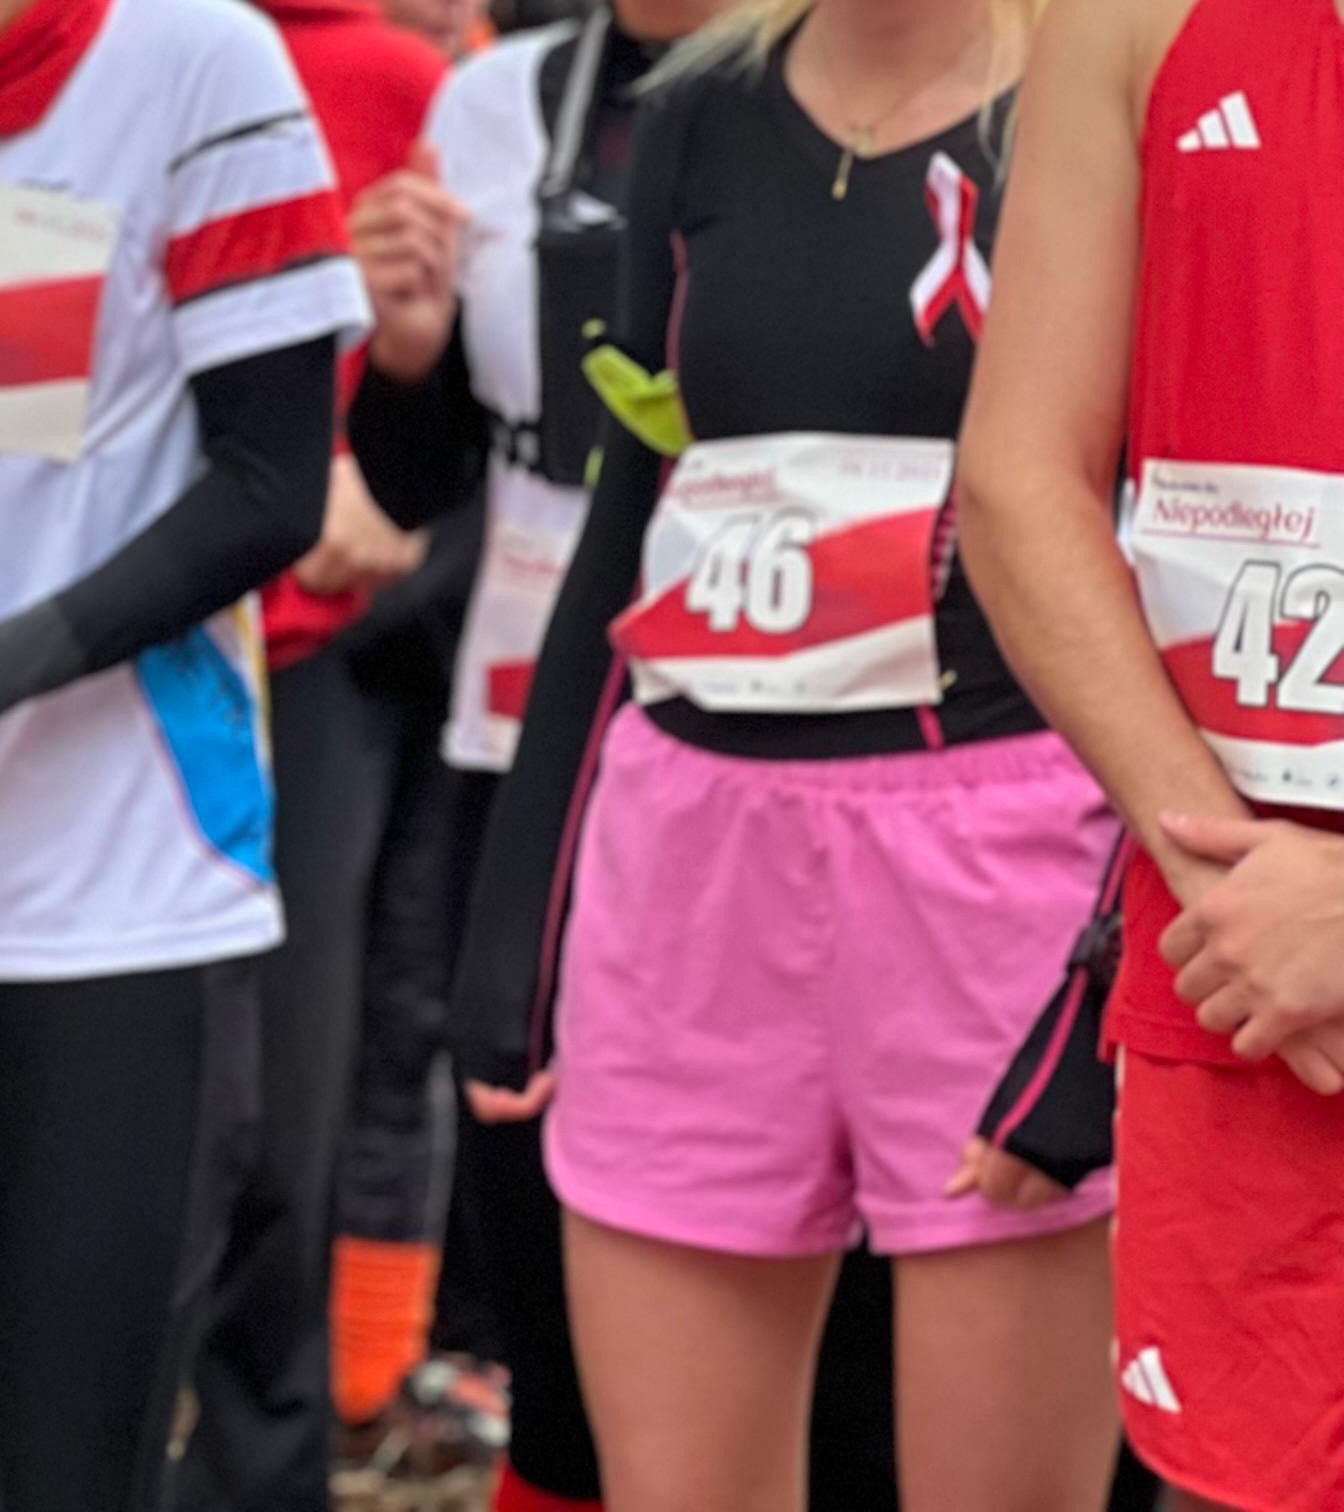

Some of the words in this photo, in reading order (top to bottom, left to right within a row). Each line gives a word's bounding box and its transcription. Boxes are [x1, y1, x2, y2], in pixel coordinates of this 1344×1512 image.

[685, 506, 820, 634] 46
[1154, 497, 1316, 539] Niepodległej
[1212, 558, 1344, 716] 42
